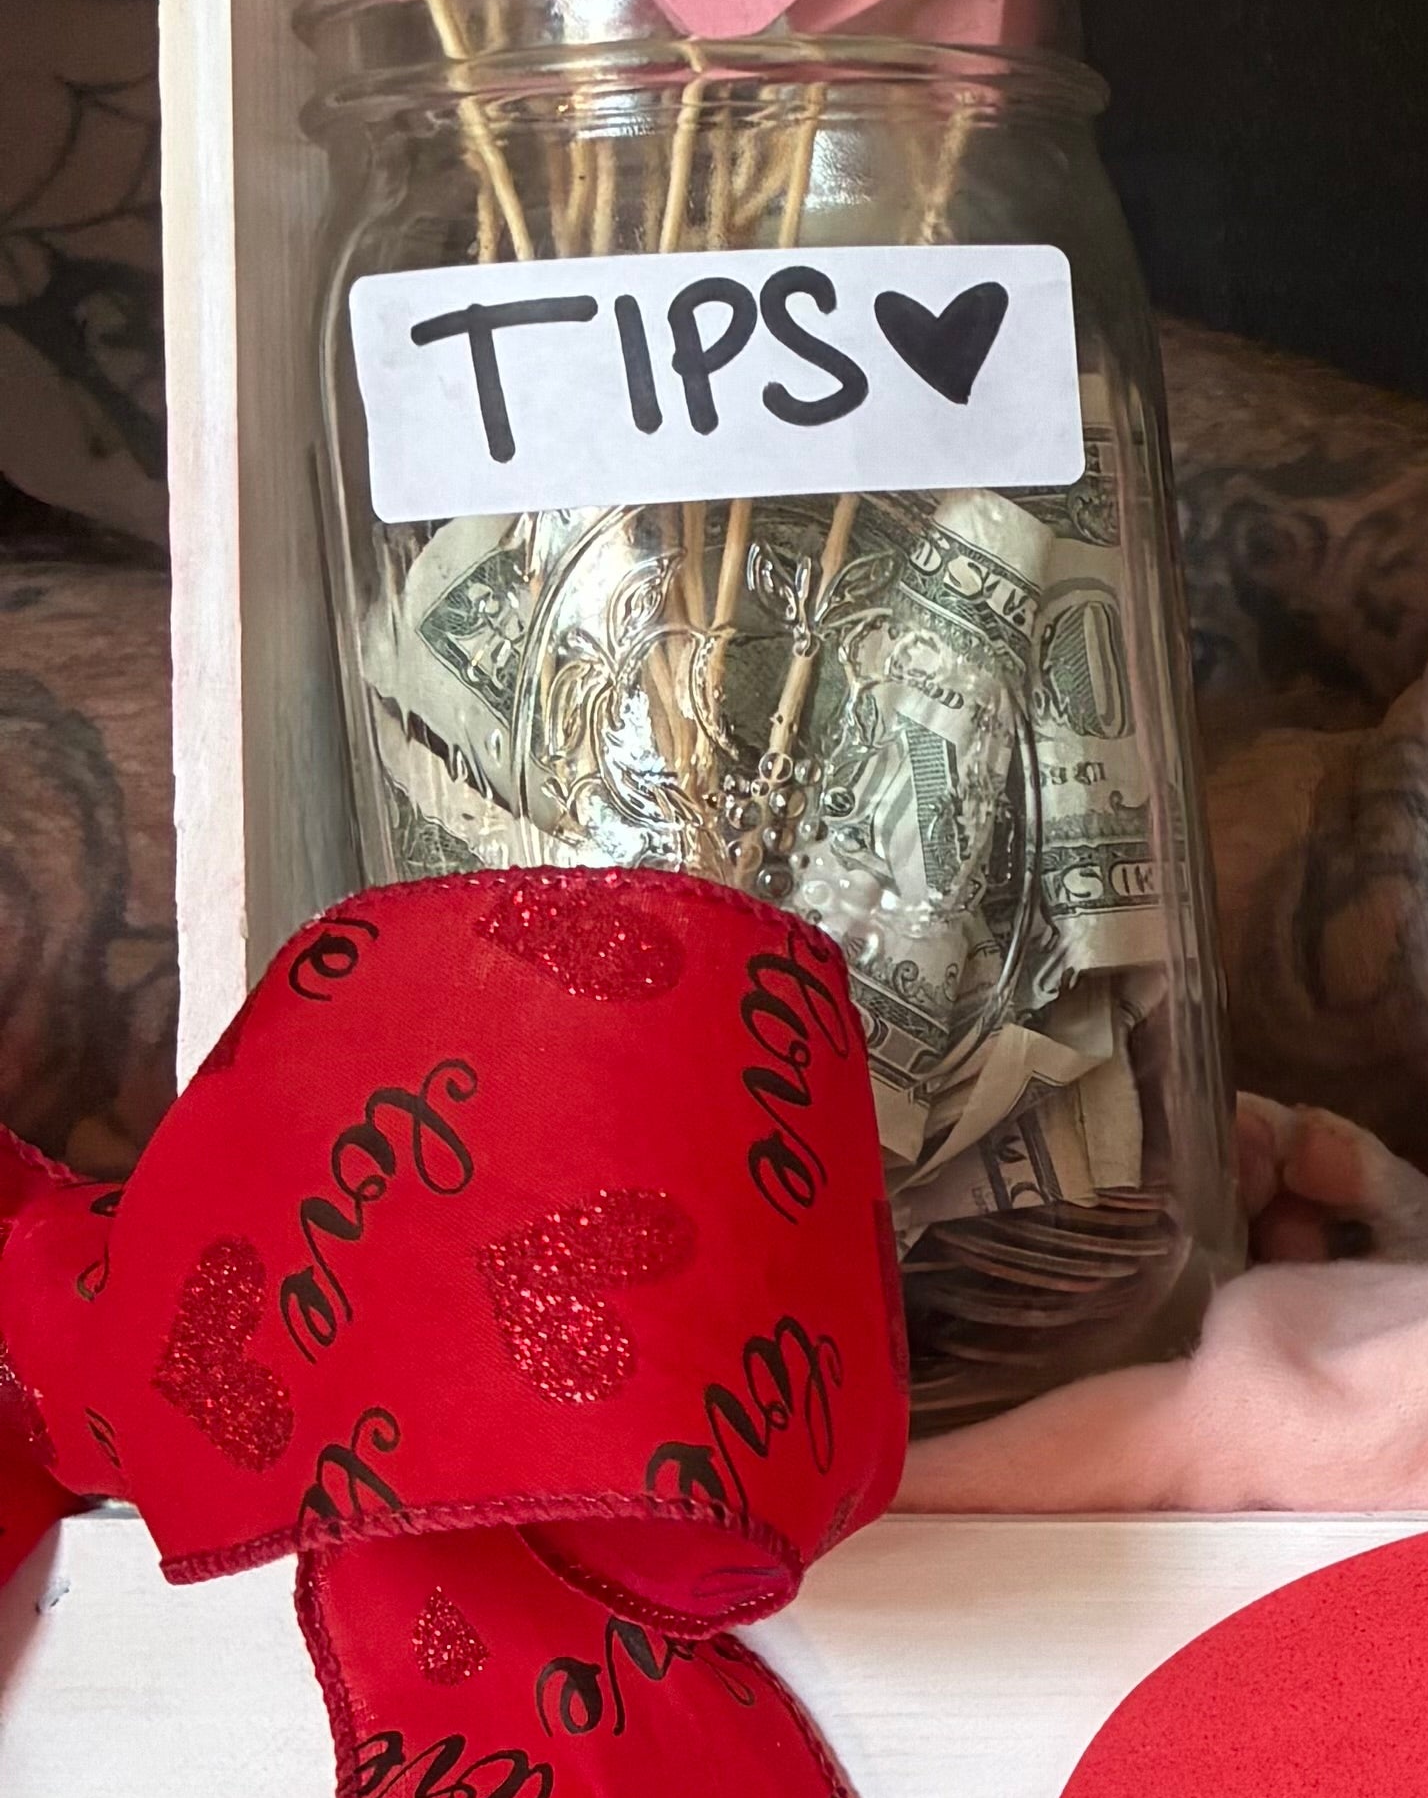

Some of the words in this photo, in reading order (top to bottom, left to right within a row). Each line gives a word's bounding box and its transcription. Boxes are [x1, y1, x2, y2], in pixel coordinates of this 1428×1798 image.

[410, 265, 870, 463] TIPS
[740, 926, 852, 1226] love
[282, 1058, 478, 1363] love
[645, 1314, 843, 1523] love
